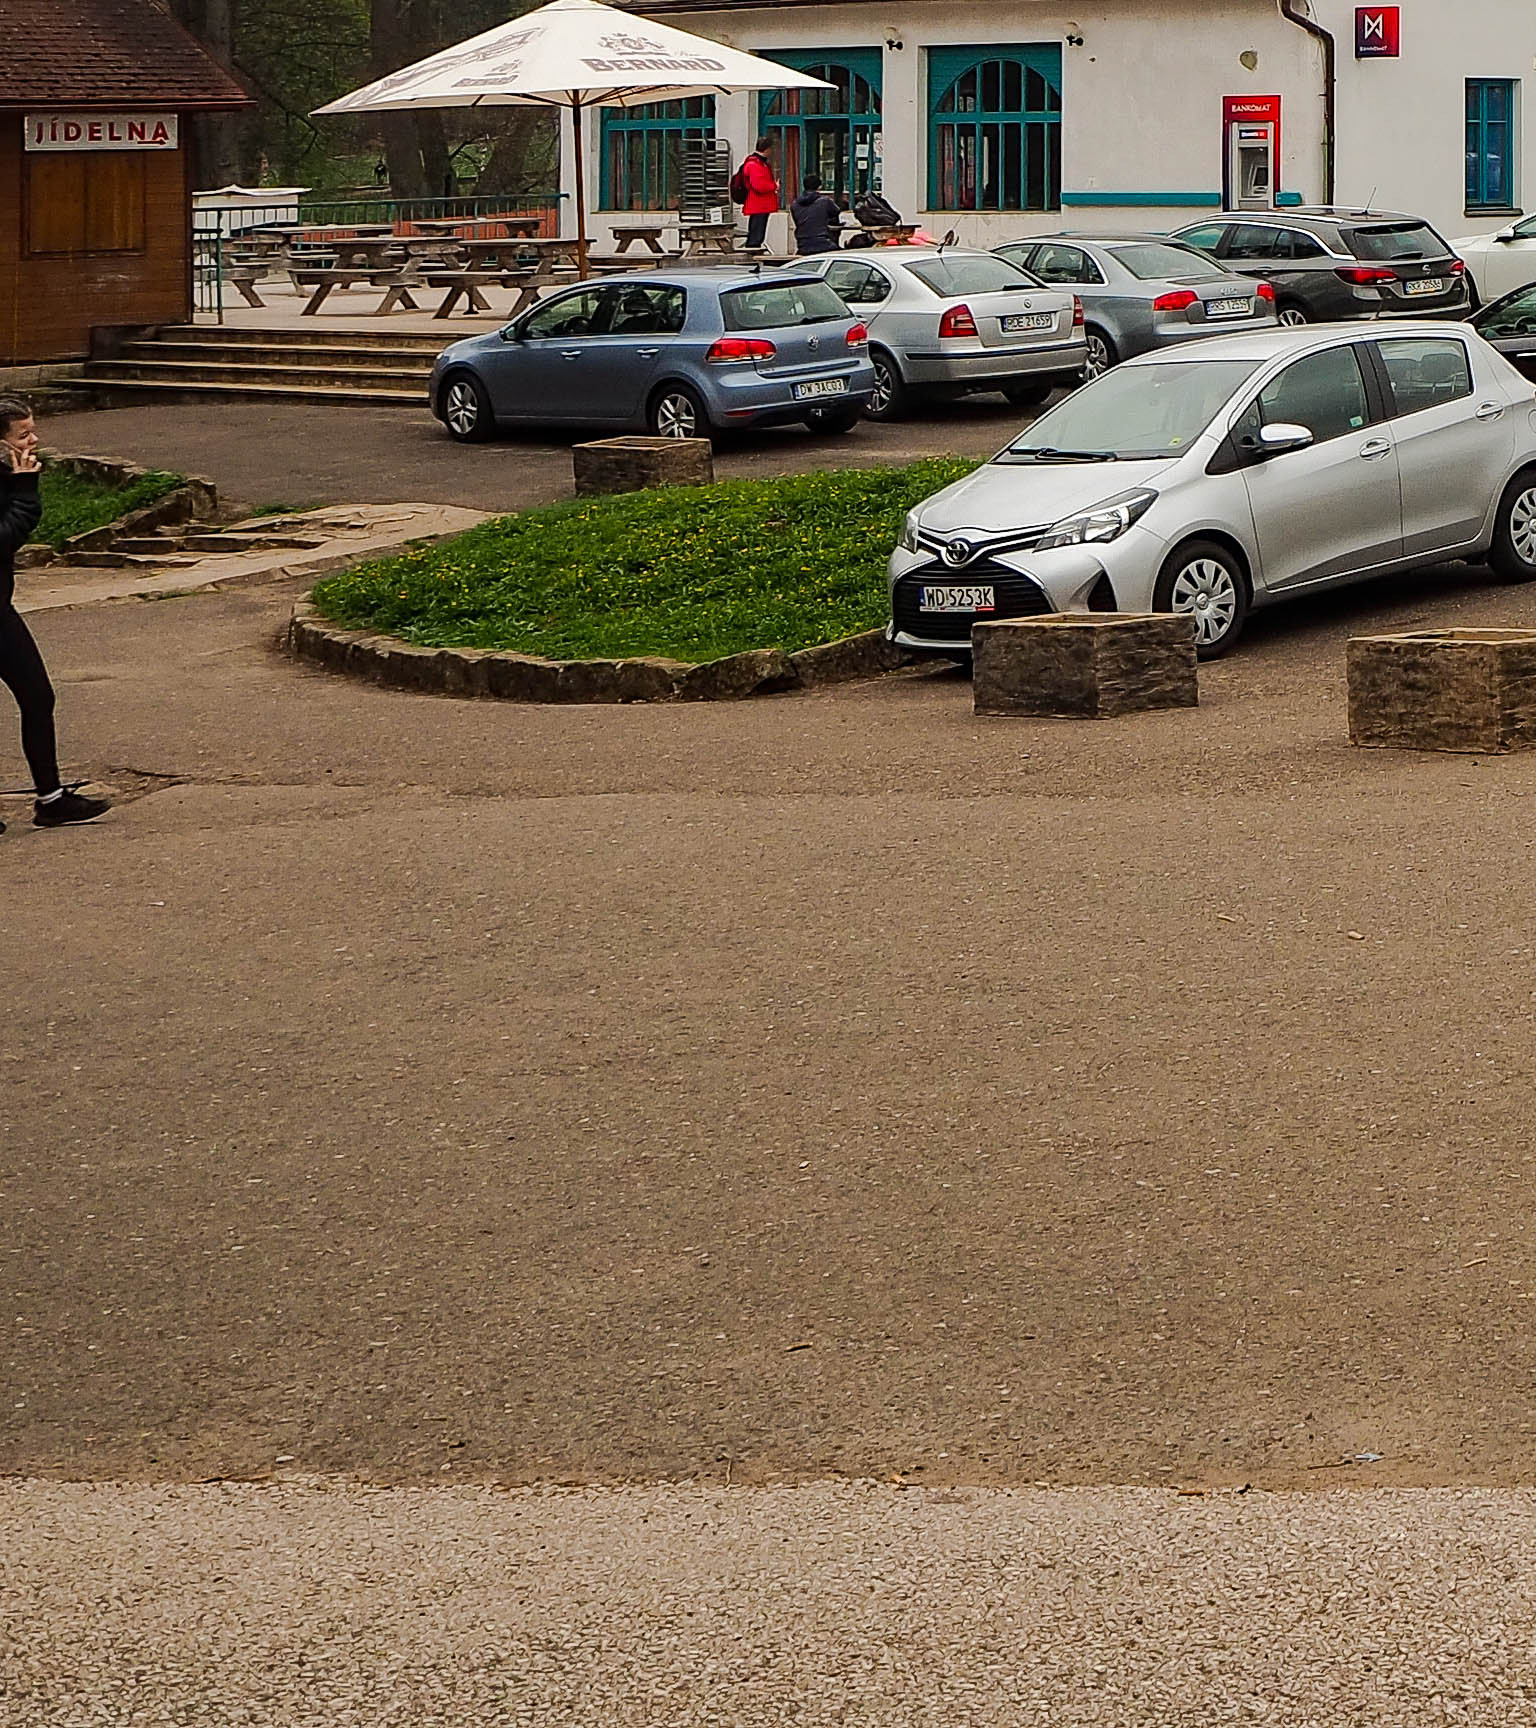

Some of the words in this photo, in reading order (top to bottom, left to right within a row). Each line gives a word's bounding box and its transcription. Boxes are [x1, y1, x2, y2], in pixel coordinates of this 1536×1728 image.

[580, 58, 726, 72] BERNARD
[1231, 103, 1272, 113] BANKOMAT
[35, 117, 169, 145] JÍDELNA
[925, 587, 946, 608] WD
[948, 587, 993, 607] 5253K
